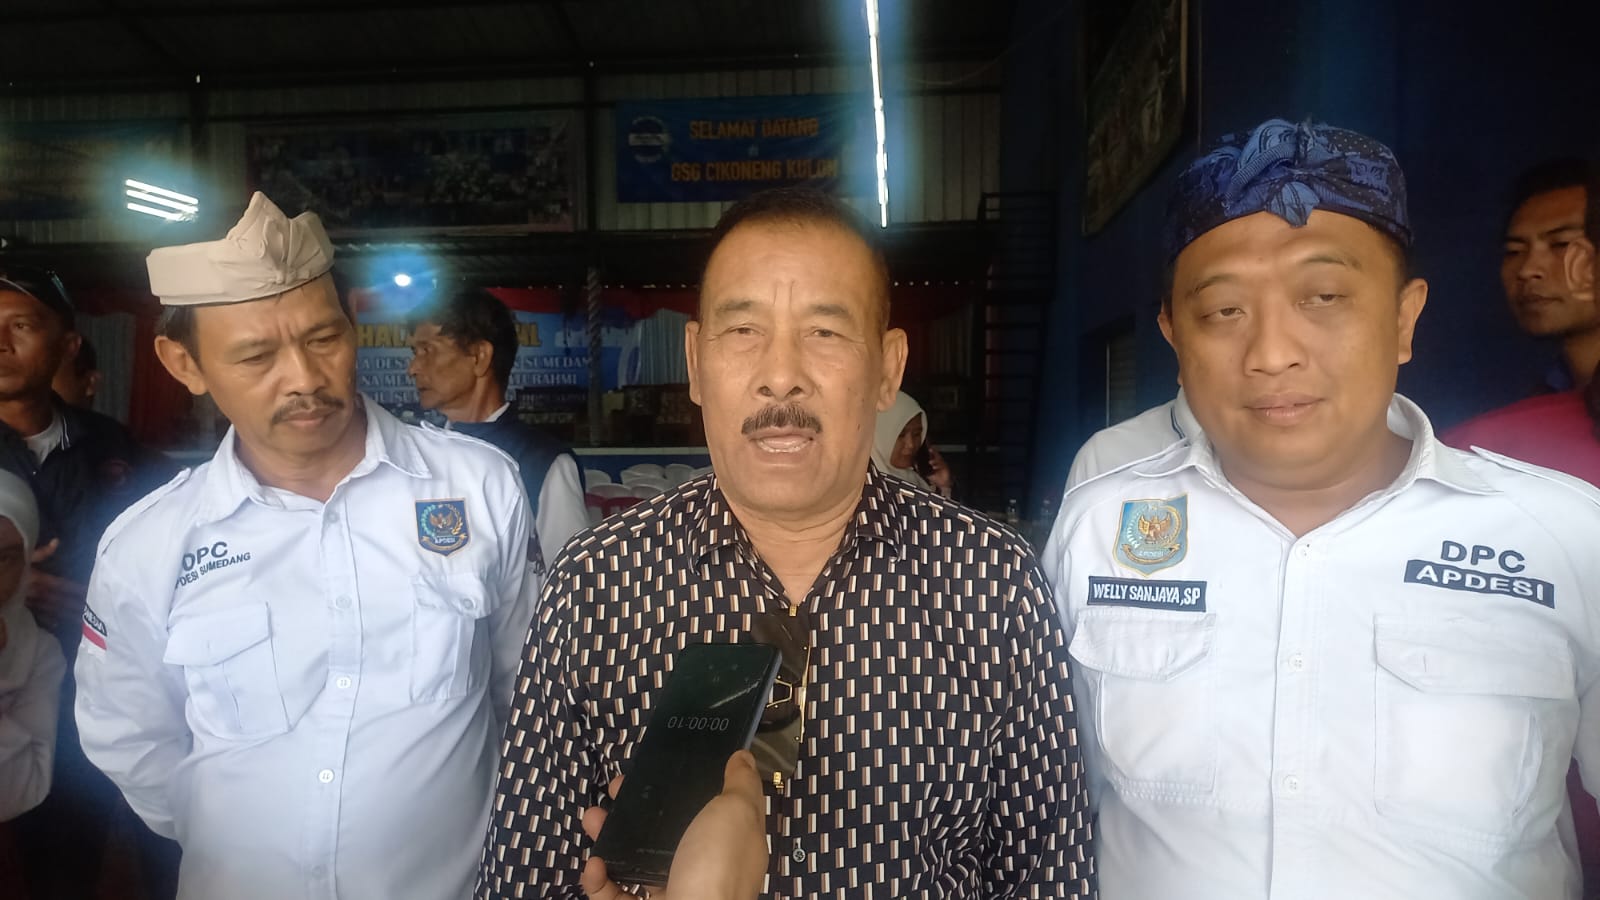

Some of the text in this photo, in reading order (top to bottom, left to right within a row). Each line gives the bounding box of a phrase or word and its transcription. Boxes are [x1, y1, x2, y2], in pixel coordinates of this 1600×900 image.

[689, 117, 819, 139] SELAMAT DATANG
[705, 159, 782, 181] CIKONENG
[182, 541, 228, 571] DPC
[199, 552, 251, 576] SUMEDANG
[1440, 540, 1526, 573] DPC
[1093, 583, 1201, 606] WELLY SANJAYA,SP
[1416, 565, 1545, 601] APDESI
[667, 716, 729, 731] 00:00:10
